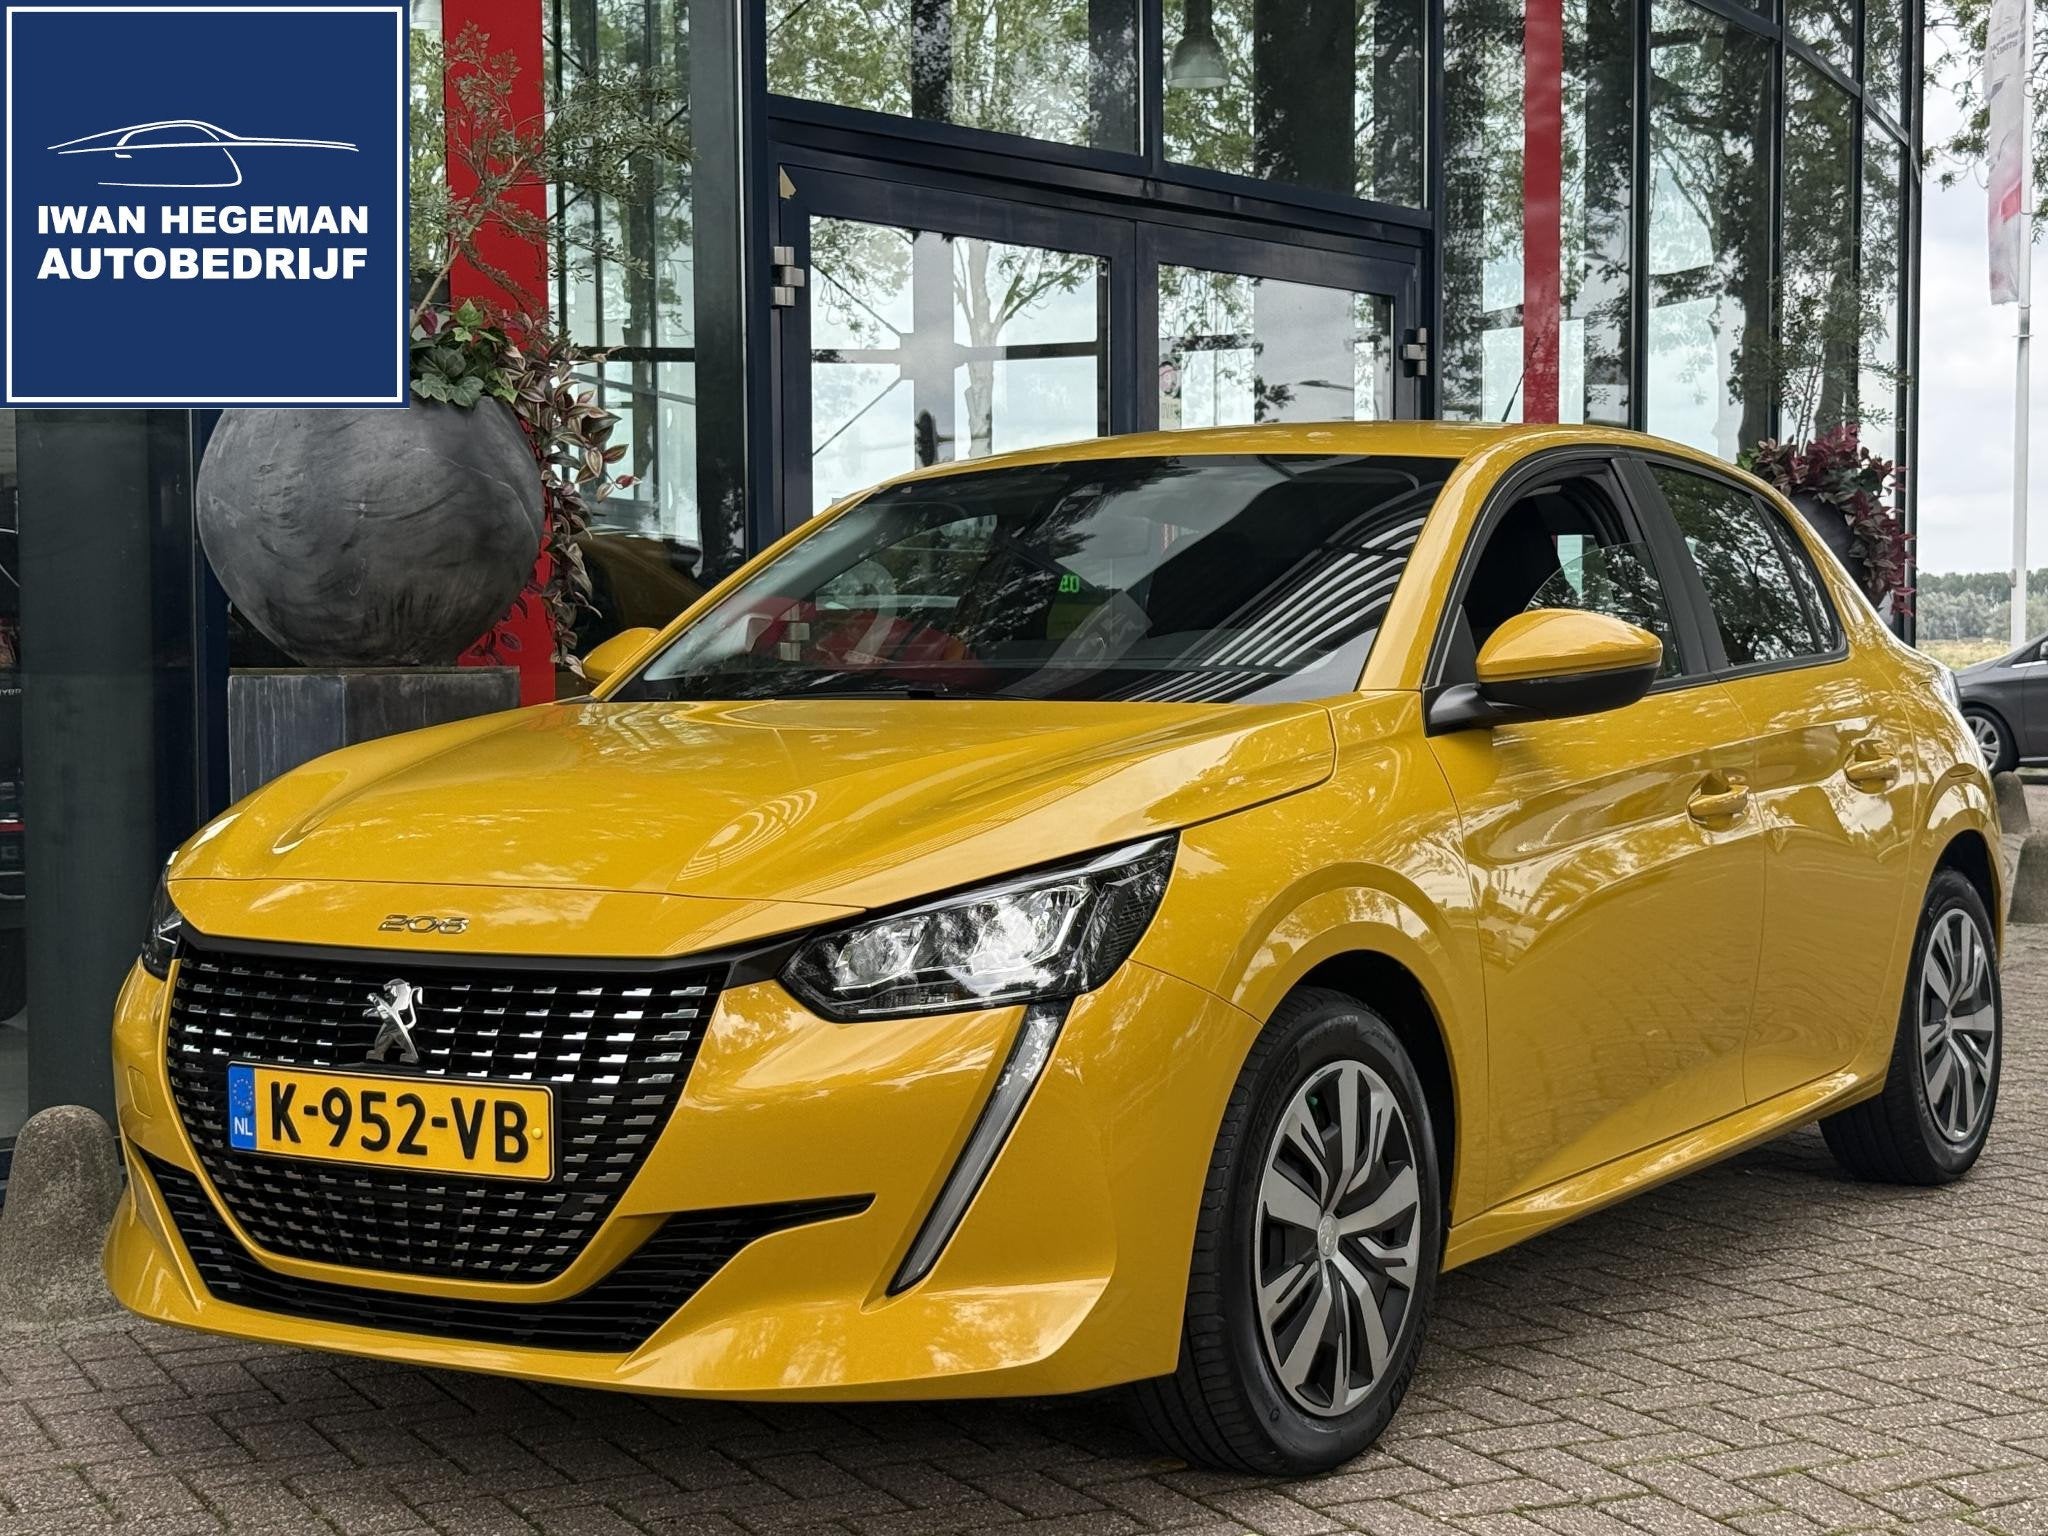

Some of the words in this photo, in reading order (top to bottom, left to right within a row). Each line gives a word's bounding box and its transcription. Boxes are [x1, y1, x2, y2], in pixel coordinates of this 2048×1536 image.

[378, 914, 470, 935] 208
[234, 1116, 253, 1137] NL
[270, 1081, 529, 1163] K-952-VB
